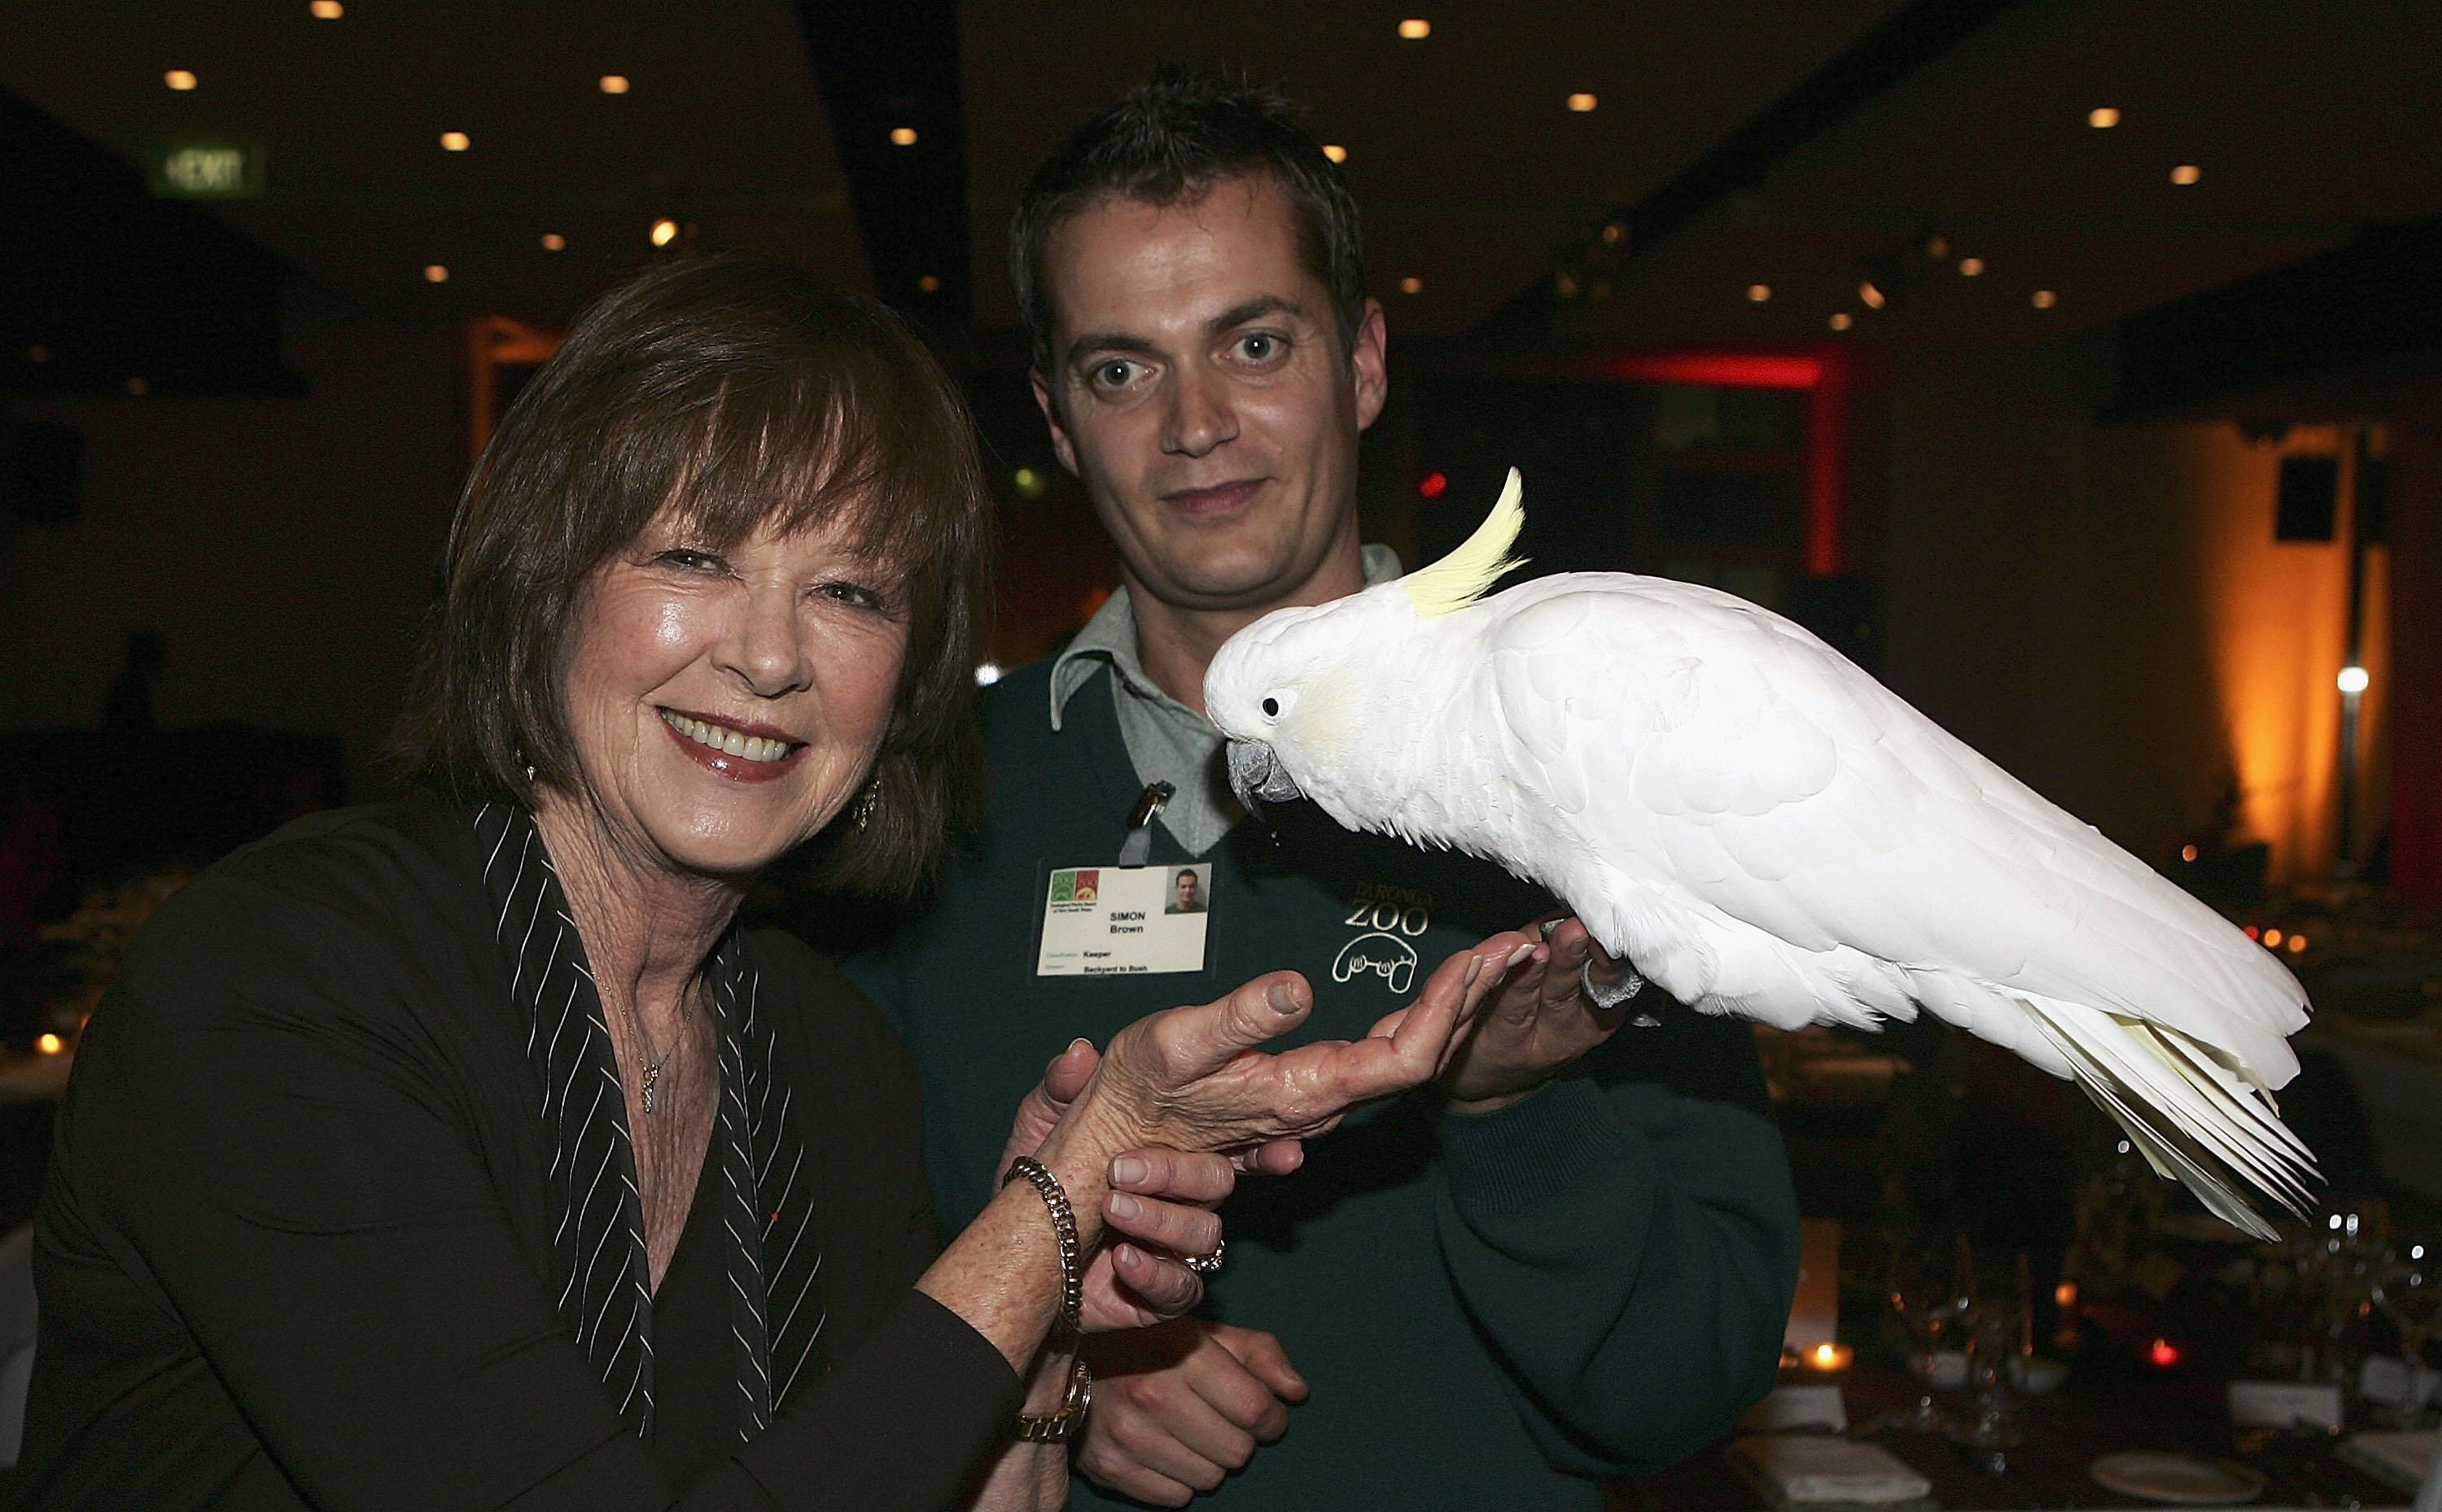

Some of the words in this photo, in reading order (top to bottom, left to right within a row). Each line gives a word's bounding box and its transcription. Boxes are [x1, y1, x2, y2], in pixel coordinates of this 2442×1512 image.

[178, 150, 242, 190] EXIT
[1109, 911, 1145, 921] SIMON
[1344, 898, 1429, 936] ZOO
[1109, 924, 1144, 933] Brown
[1083, 951, 1111, 959] Keeper
[1084, 965, 1118, 974] Backyard
